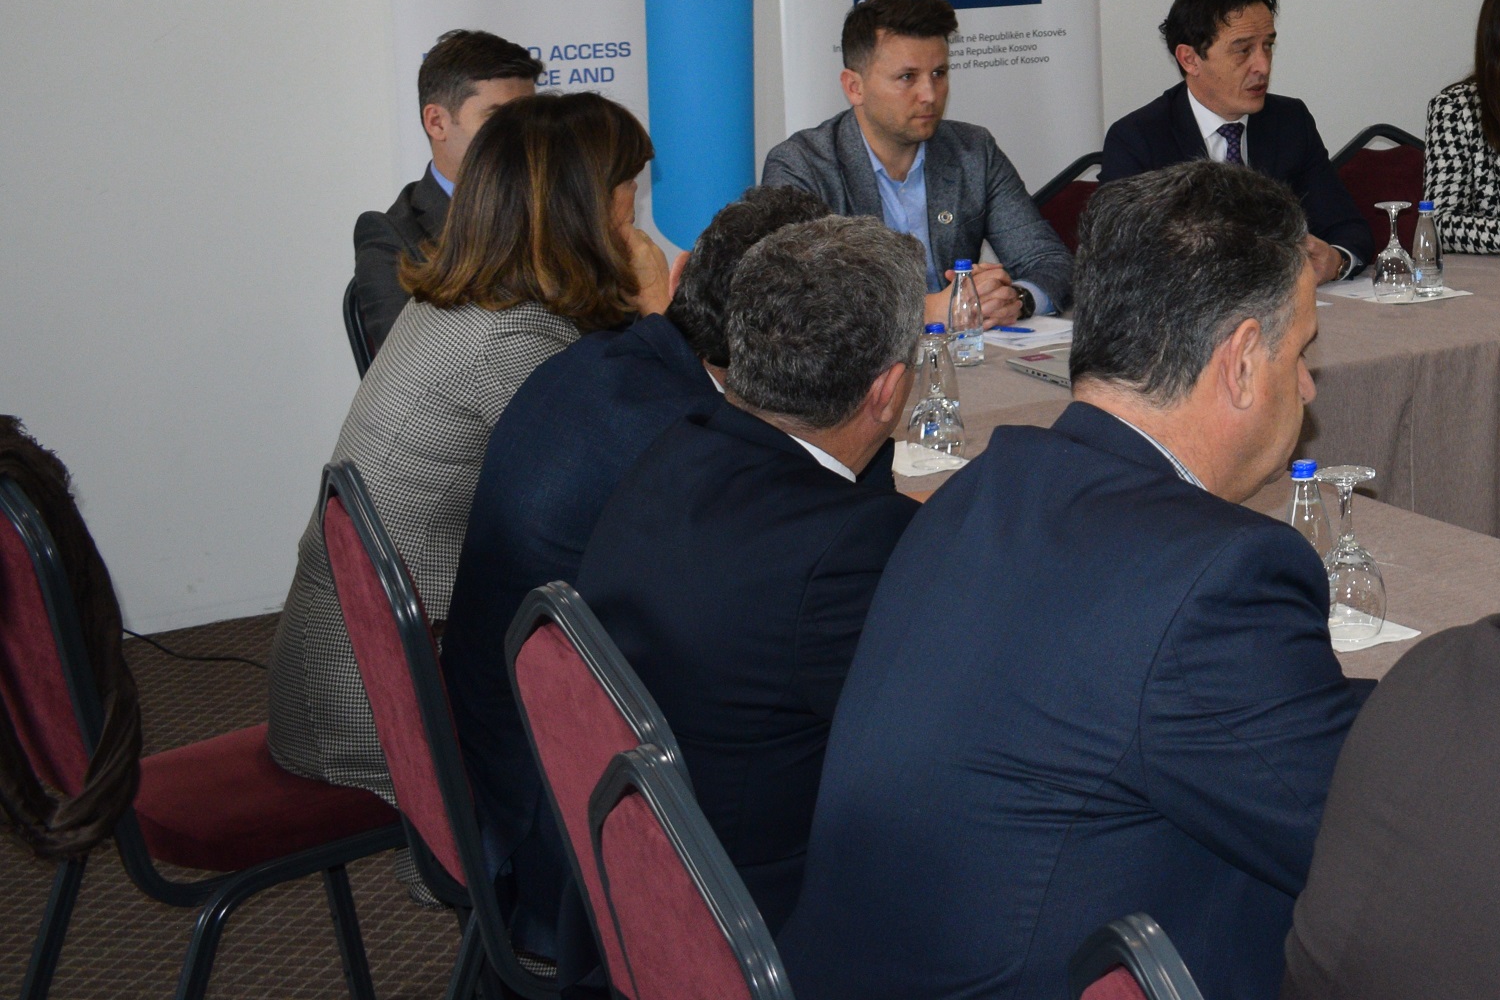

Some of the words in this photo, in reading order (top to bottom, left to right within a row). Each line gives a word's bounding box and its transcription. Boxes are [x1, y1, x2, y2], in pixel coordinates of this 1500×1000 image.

[549, 41, 632, 61] ACCESS
[966, 45, 1007, 57] Republike
[1008, 43, 1038, 53] Kosovo
[963, 60, 972, 69] of
[973, 58, 1009, 69] Republic
[1010, 56, 1019, 65] of
[1020, 55, 1050, 65] Kosovo
[568, 66, 615, 84] AND
